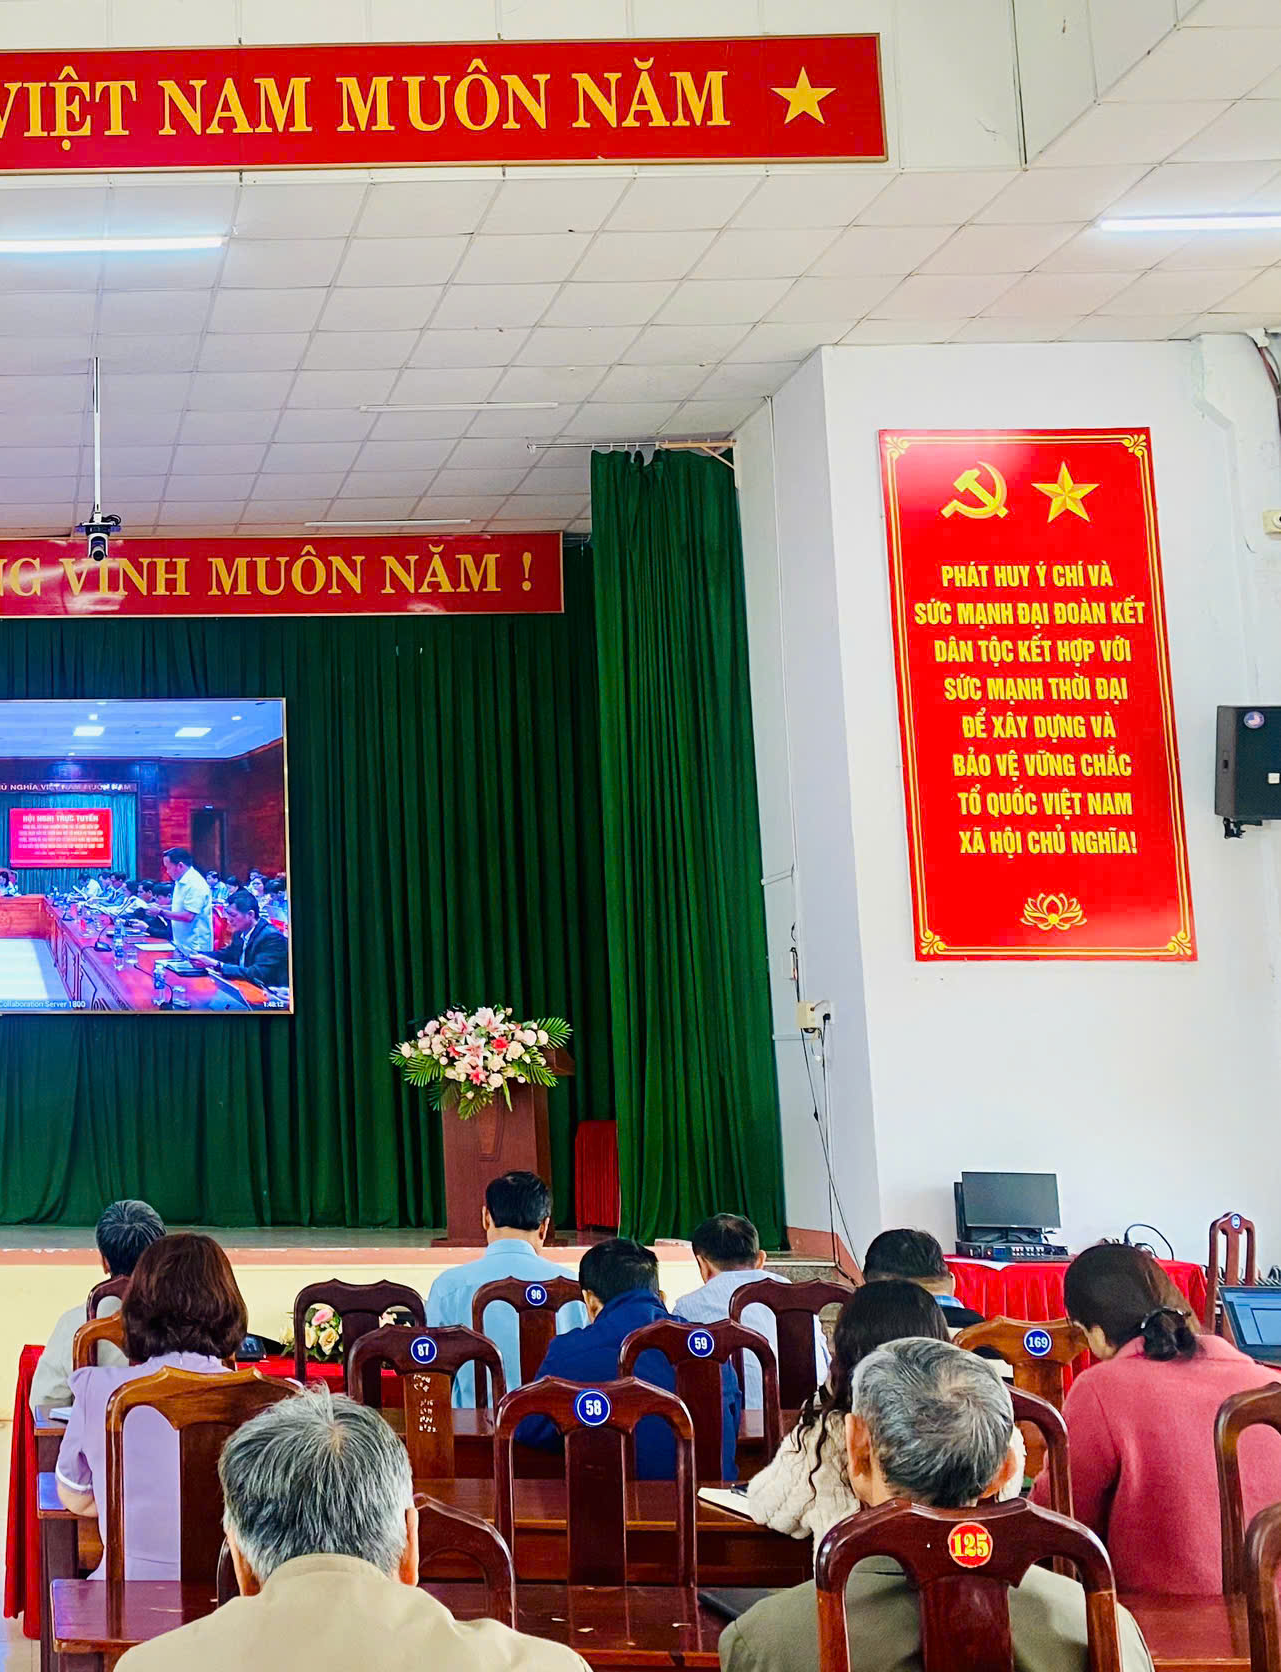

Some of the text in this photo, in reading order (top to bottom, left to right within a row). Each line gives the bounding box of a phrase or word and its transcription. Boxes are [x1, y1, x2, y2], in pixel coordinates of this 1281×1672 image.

[157, 77, 313, 136] NAM
[335, 58, 551, 134] MUÔN
[571, 57, 731, 128] NĂM
[59, 557, 190, 597] VINH
[207, 545, 365, 597] MUÔN
[381, 544, 502, 593] NĂM
[522, 552, 532, 591] !
[941, 560, 1114, 587] PHÁT HUY Ý CHÍ VÀ
[915, 595, 1145, 629] SỨC MẠNH ĐẠI ĐOÀN KẾT
[934, 633, 1131, 667] DÂN TỘC KẾT HỢP VỚI
[944, 673, 1128, 705] SỨC MẠNH THỜI ĐẠI
[962, 707, 1117, 743] ĐỂ XÂY DỰNG VÀ
[953, 746, 1132, 781] BẢO VỆ VỮNG CHẮC
[958, 784, 1133, 820] TỔ QUỐC VIỆT NAM
[959, 824, 1138, 858] XÃ HỘI CHỦ NGHĨA!
[45, 1000, 67, 1008] Server
[68, 1000, 86, 1008] 1800
[530, 1289, 542, 1300] 96
[417, 1343, 430, 1357] 87
[694, 1337, 708, 1350] 59
[1028, 1336, 1048, 1349] 169
[585, 1399, 602, 1416] 58
[952, 1533, 989, 1557] 125
